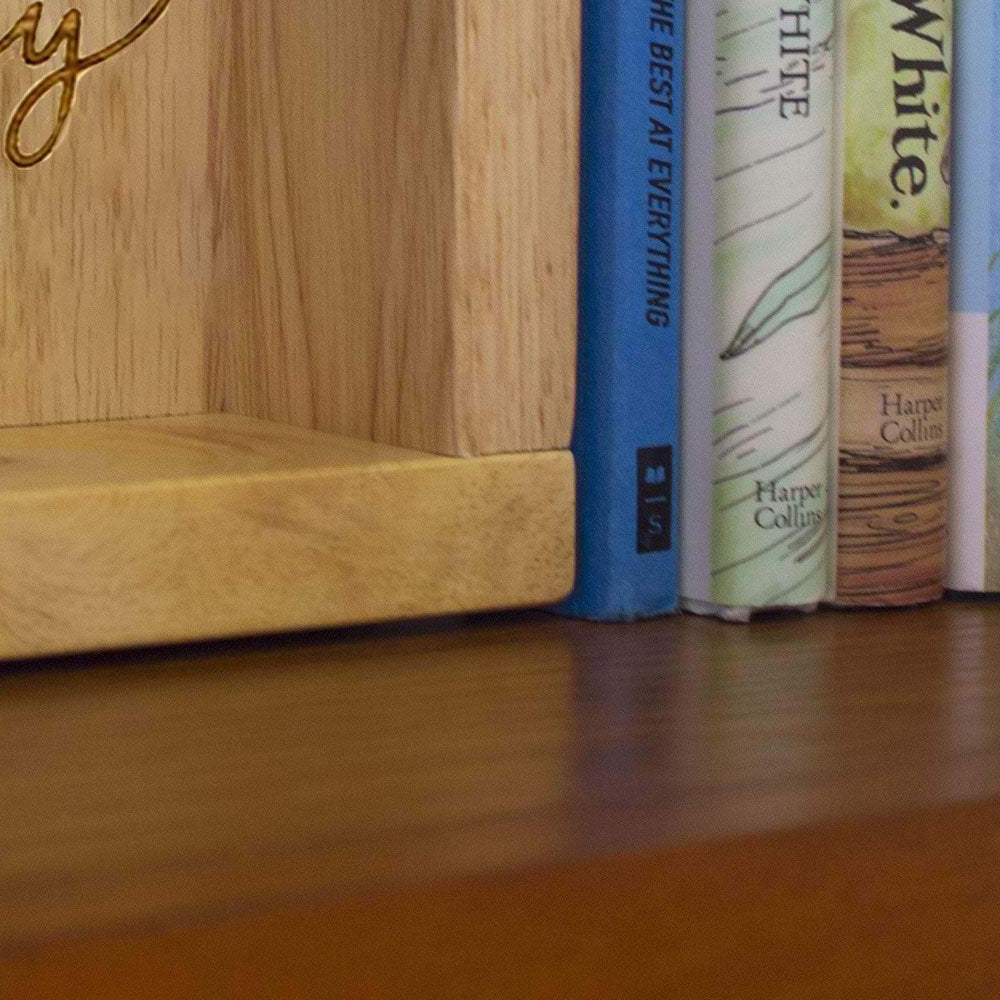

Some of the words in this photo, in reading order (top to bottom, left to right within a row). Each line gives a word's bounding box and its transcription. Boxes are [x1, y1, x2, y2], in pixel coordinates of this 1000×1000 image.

[648, 41, 674, 114] BEST
[648, 116, 673, 152] AT
[645, 157, 673, 328] EVERYTHING
[880, 393, 944, 421] Harper
[880, 419, 944, 444] Collins
[755, 478, 823, 507] Harper
[754, 505, 823, 530] Collins
